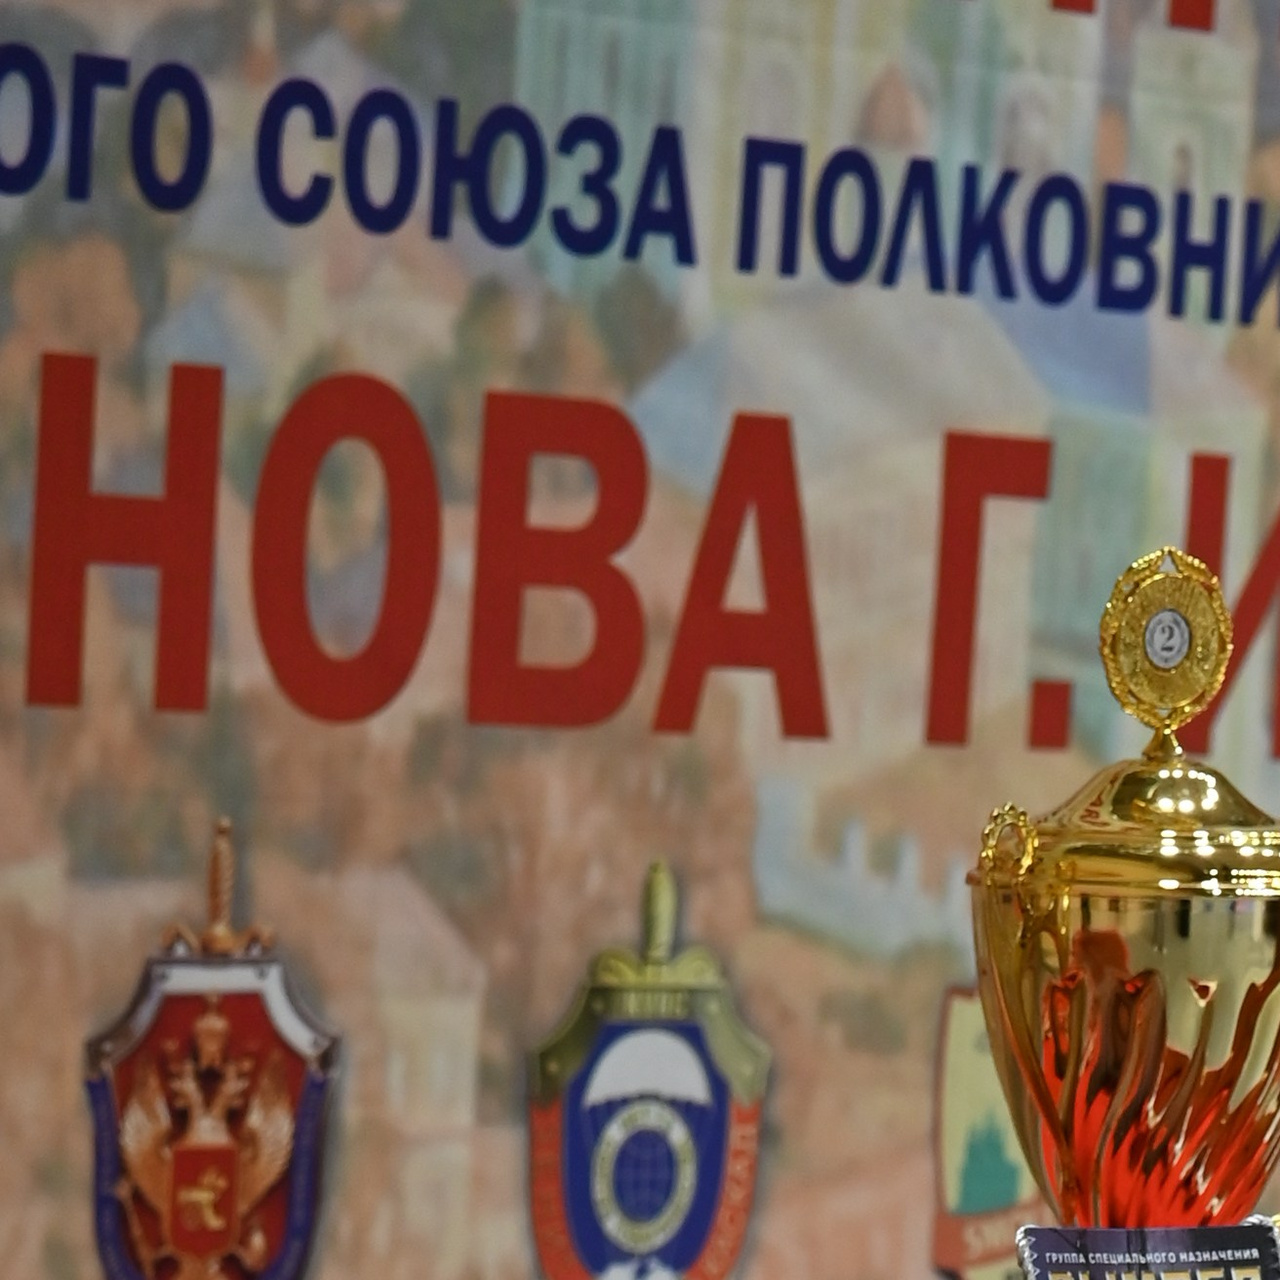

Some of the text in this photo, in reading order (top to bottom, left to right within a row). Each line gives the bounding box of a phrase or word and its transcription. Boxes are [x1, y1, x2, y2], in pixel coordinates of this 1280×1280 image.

[0, 42, 213, 212] ОГО
[256, 77, 698, 267] СОЮЗА
[26, 350, 832, 741] НОВА
[1161, 624, 1175, 652] 2
[1045, 1248, 1260, 1265] ГРУППА СПЕЦИАЛЬНОГО НАЗНАЧЕНИЯ
